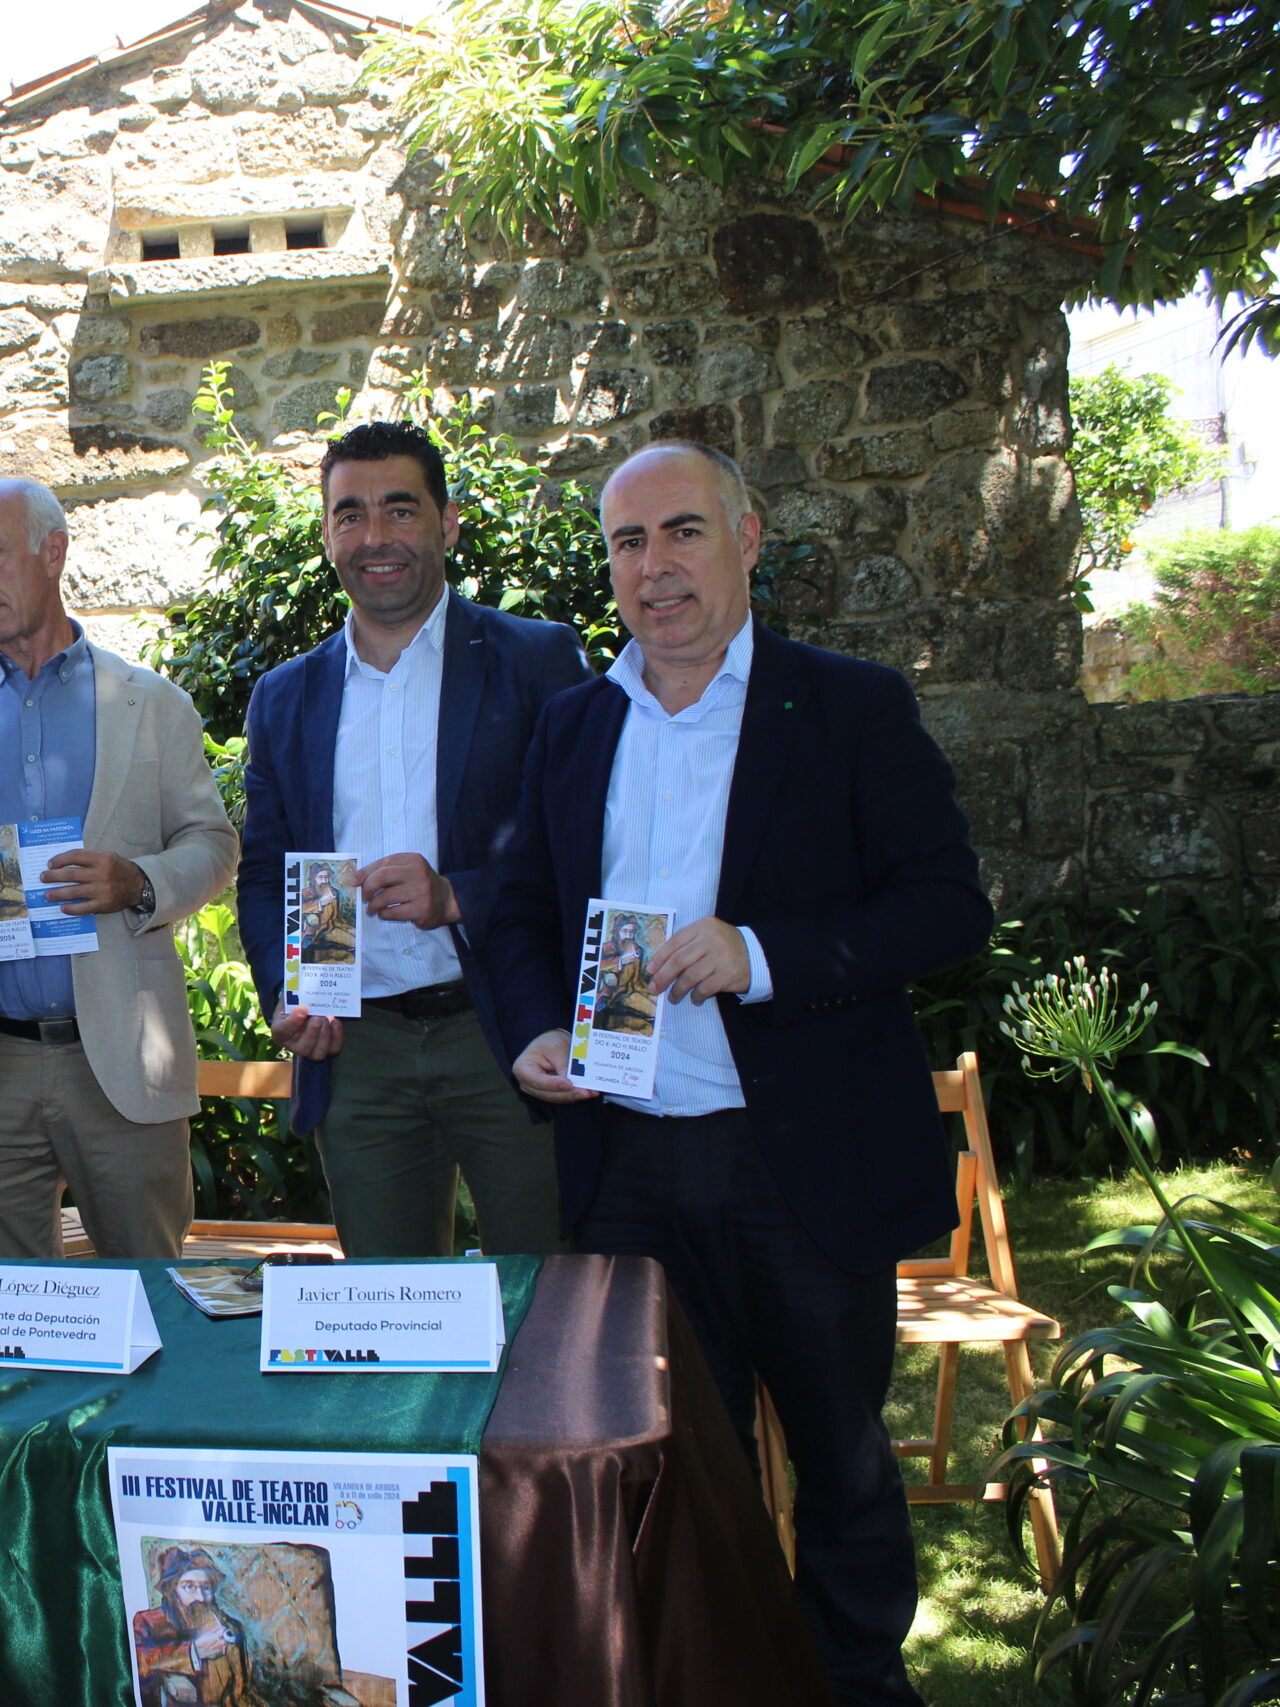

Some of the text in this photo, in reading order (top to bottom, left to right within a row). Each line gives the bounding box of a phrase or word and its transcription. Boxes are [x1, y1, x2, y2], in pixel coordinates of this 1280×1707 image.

[286, 861, 300, 1006] FESTIVALLE
[570, 910, 604, 1077] FESTIVALLE
[611, 1051, 631, 1060] 2024
[43, 1280, 101, 1299] Diéguez
[297, 1286, 462, 1302] Javier Tourís Romero
[17, 1311, 33, 1322] da
[35, 1312, 101, 1326] Deputación
[315, 1320, 442, 1333] Deputado Provincial
[12, 1325, 27, 1337] de
[28, 1327, 97, 1341] Pontevedra
[270, 1349, 380, 1363] FESTIVALLE
[121, 1475, 329, 1504] III FESTIVAL DE TEATRO
[201, 1500, 330, 1526] VALLE-INCLAN
